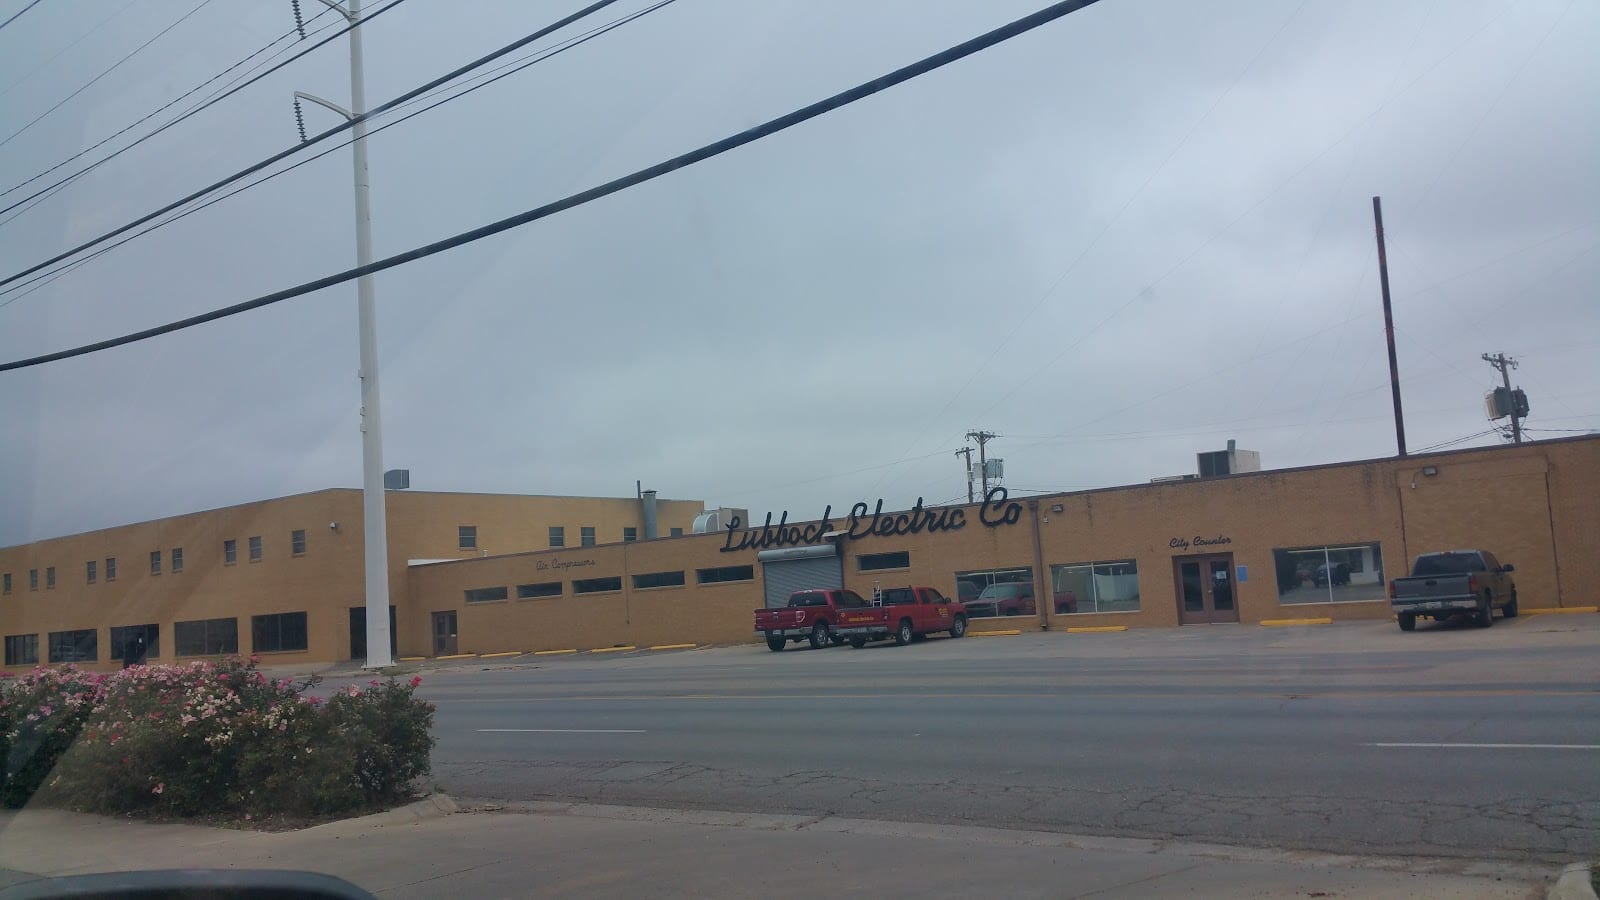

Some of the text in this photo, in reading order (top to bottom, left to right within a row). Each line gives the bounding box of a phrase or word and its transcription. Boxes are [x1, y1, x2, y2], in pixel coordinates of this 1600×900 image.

[720, 486, 1023, 553] Lubbock Electric Co
[1169, 535, 1232, 551] City Counter
